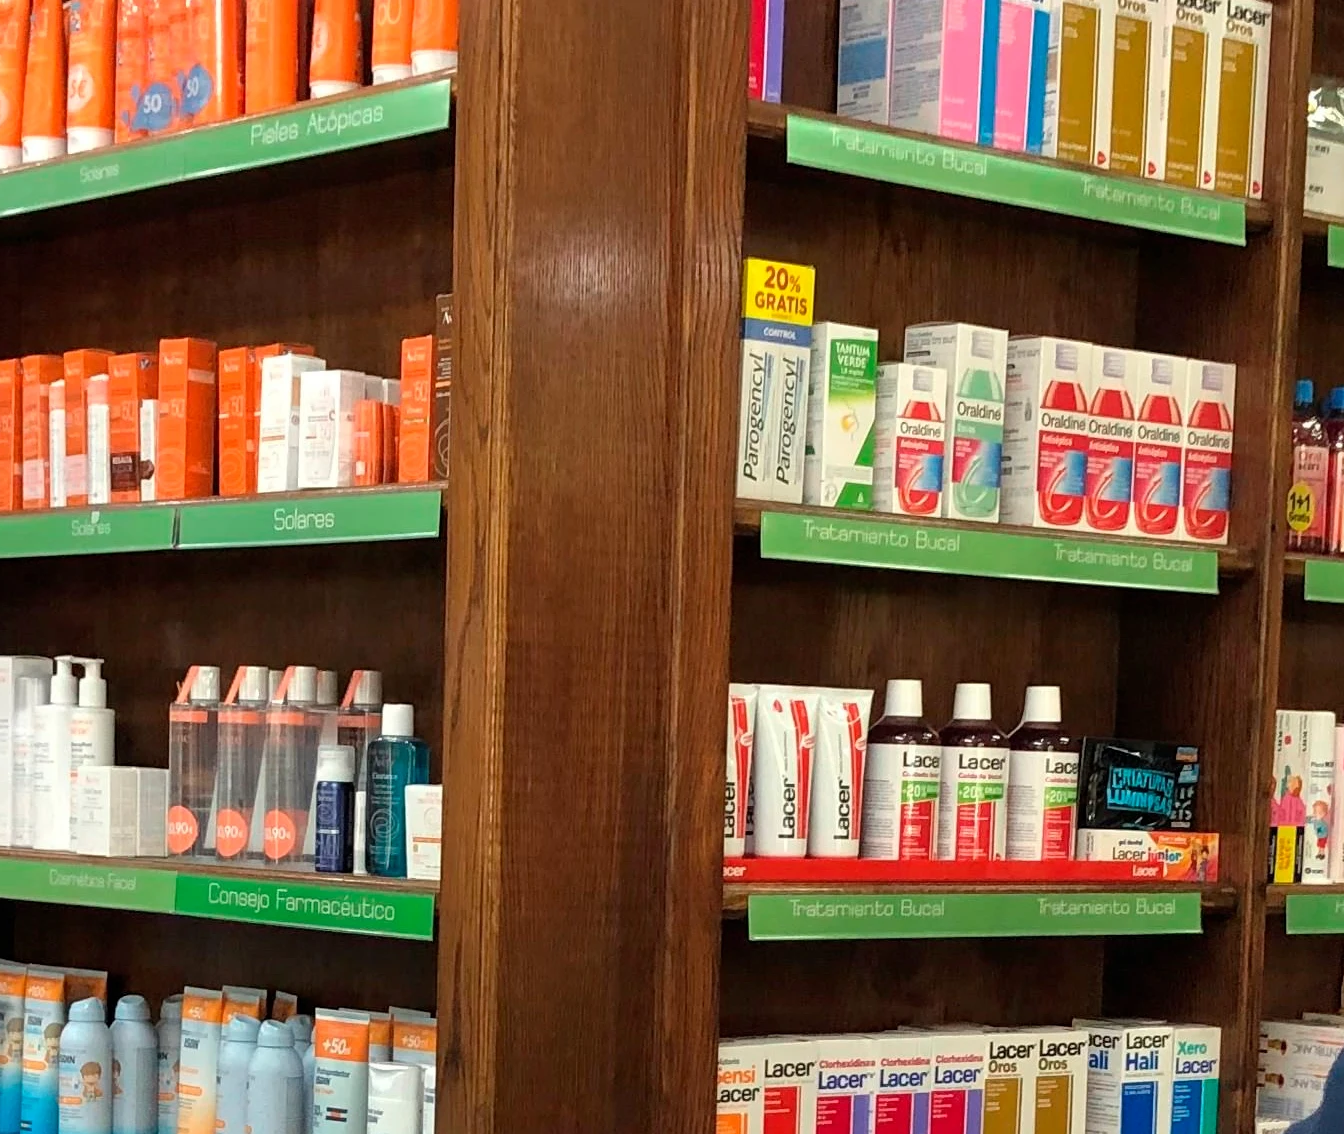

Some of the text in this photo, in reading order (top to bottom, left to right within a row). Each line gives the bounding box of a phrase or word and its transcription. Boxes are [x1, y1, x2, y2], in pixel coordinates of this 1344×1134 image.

[1175, 9, 1204, 25] Oros
[1226, 5, 1271, 26] Lacer
[1225, 20, 1253, 37] Oros
[186, 77, 199, 96] 50
[143, 93, 162, 114] 50
[250, 104, 384, 146] Pieles Atópicas
[830, 127, 987, 176] Tratamiento Bucal
[1180, 197, 1220, 221] Bucal
[764, 265, 801, 293] 20%
[754, 291, 807, 316] GRATIS
[763, 326, 796, 340] CONTROL
[835, 341, 870, 358] TANTUM
[836, 355, 867, 369] VERDE
[743, 352, 765, 482] Parogencyl
[957, 401, 1001, 421] Oraldine
[776, 357, 797, 485] Parogencyl
[899, 421, 941, 438] Oraldine
[1041, 412, 1087, 432] Oraldine
[1088, 420, 1133, 439] Oraldine
[1137, 425, 1181, 444] Oraldine
[1187, 432, 1231, 450] Oraldine
[1289, 492, 1310, 512] 1+1
[274, 508, 335, 531] Solares
[802, 519, 960, 553] Tratamiento Bucal
[1053, 543, 1194, 572] Tratamiento Bucal
[958, 753, 1006, 770] Lacer
[1110, 768, 1175, 796] CRIATURAS
[778, 775, 796, 840] Lacer
[833, 777, 850, 840] Lacer
[1112, 847, 1182, 862] Lacer junior
[1132, 865, 1159, 877] Lacer
[208, 883, 396, 921] Consejo Farmacéutico
[790, 899, 945, 918] Tratamiento Bucal
[1038, 899, 1176, 915] Tratamiento Bucal
[1039, 1039, 1086, 1057] Lacer
[1126, 1028, 1171, 1050] Lacer
[1177, 1041, 1207, 1056] Xero
[935, 1054, 984, 1064] Clorhexidina
[989, 1041, 1035, 1060] Lacer
[765, 1059, 816, 1079] Lacer
[880, 1057, 931, 1067] Clorhexidina
[988, 1060, 1017, 1073] Oros
[1038, 1058, 1068, 1071] Oros
[1125, 1051, 1159, 1071] Hali
[1175, 1058, 1216, 1075] Lacer
[818, 1071, 868, 1090] Lacer
[880, 1069, 928, 1088] Lacer
[934, 1066, 981, 1085] Lacer
